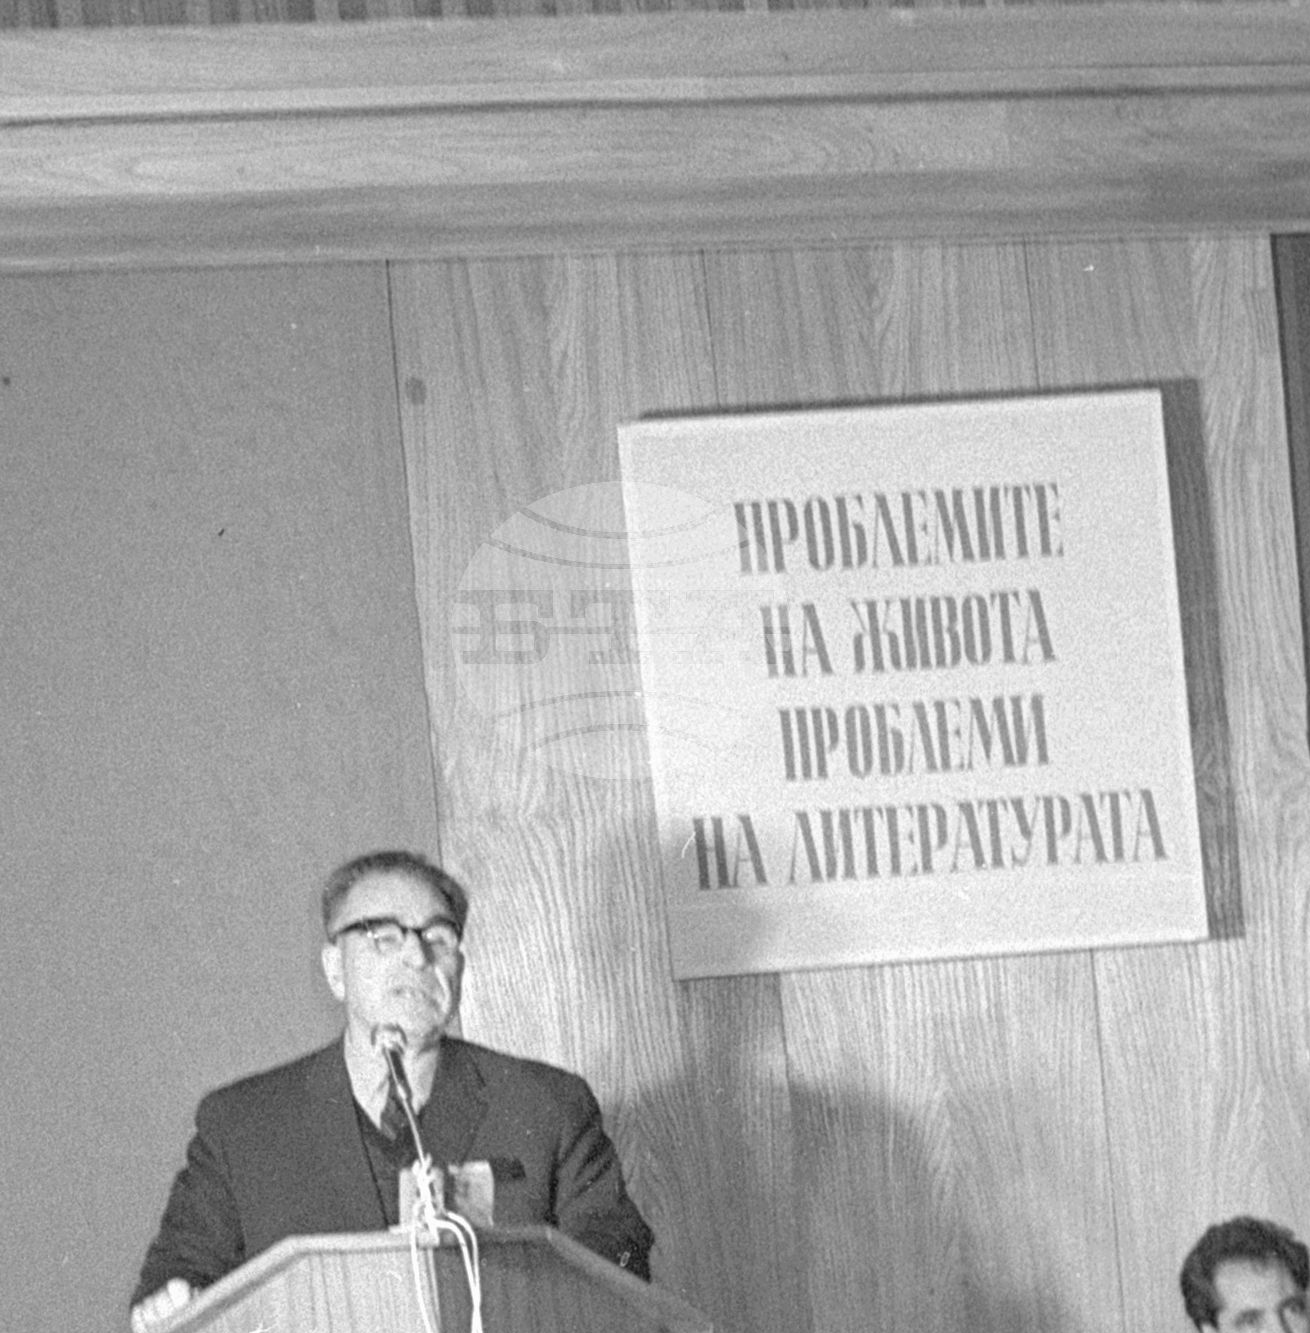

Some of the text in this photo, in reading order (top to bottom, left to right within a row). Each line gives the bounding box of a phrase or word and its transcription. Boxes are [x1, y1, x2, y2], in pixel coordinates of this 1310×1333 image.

[733, 482, 1066, 574] ПРОБЛЕМИТЕ
[760, 588, 1057, 679] НА ЖИВОТА
[778, 693, 1050, 782] ПРОБЛЕМИ
[692, 787, 1169, 891] НА ЛИТЕРАТУРАТА
